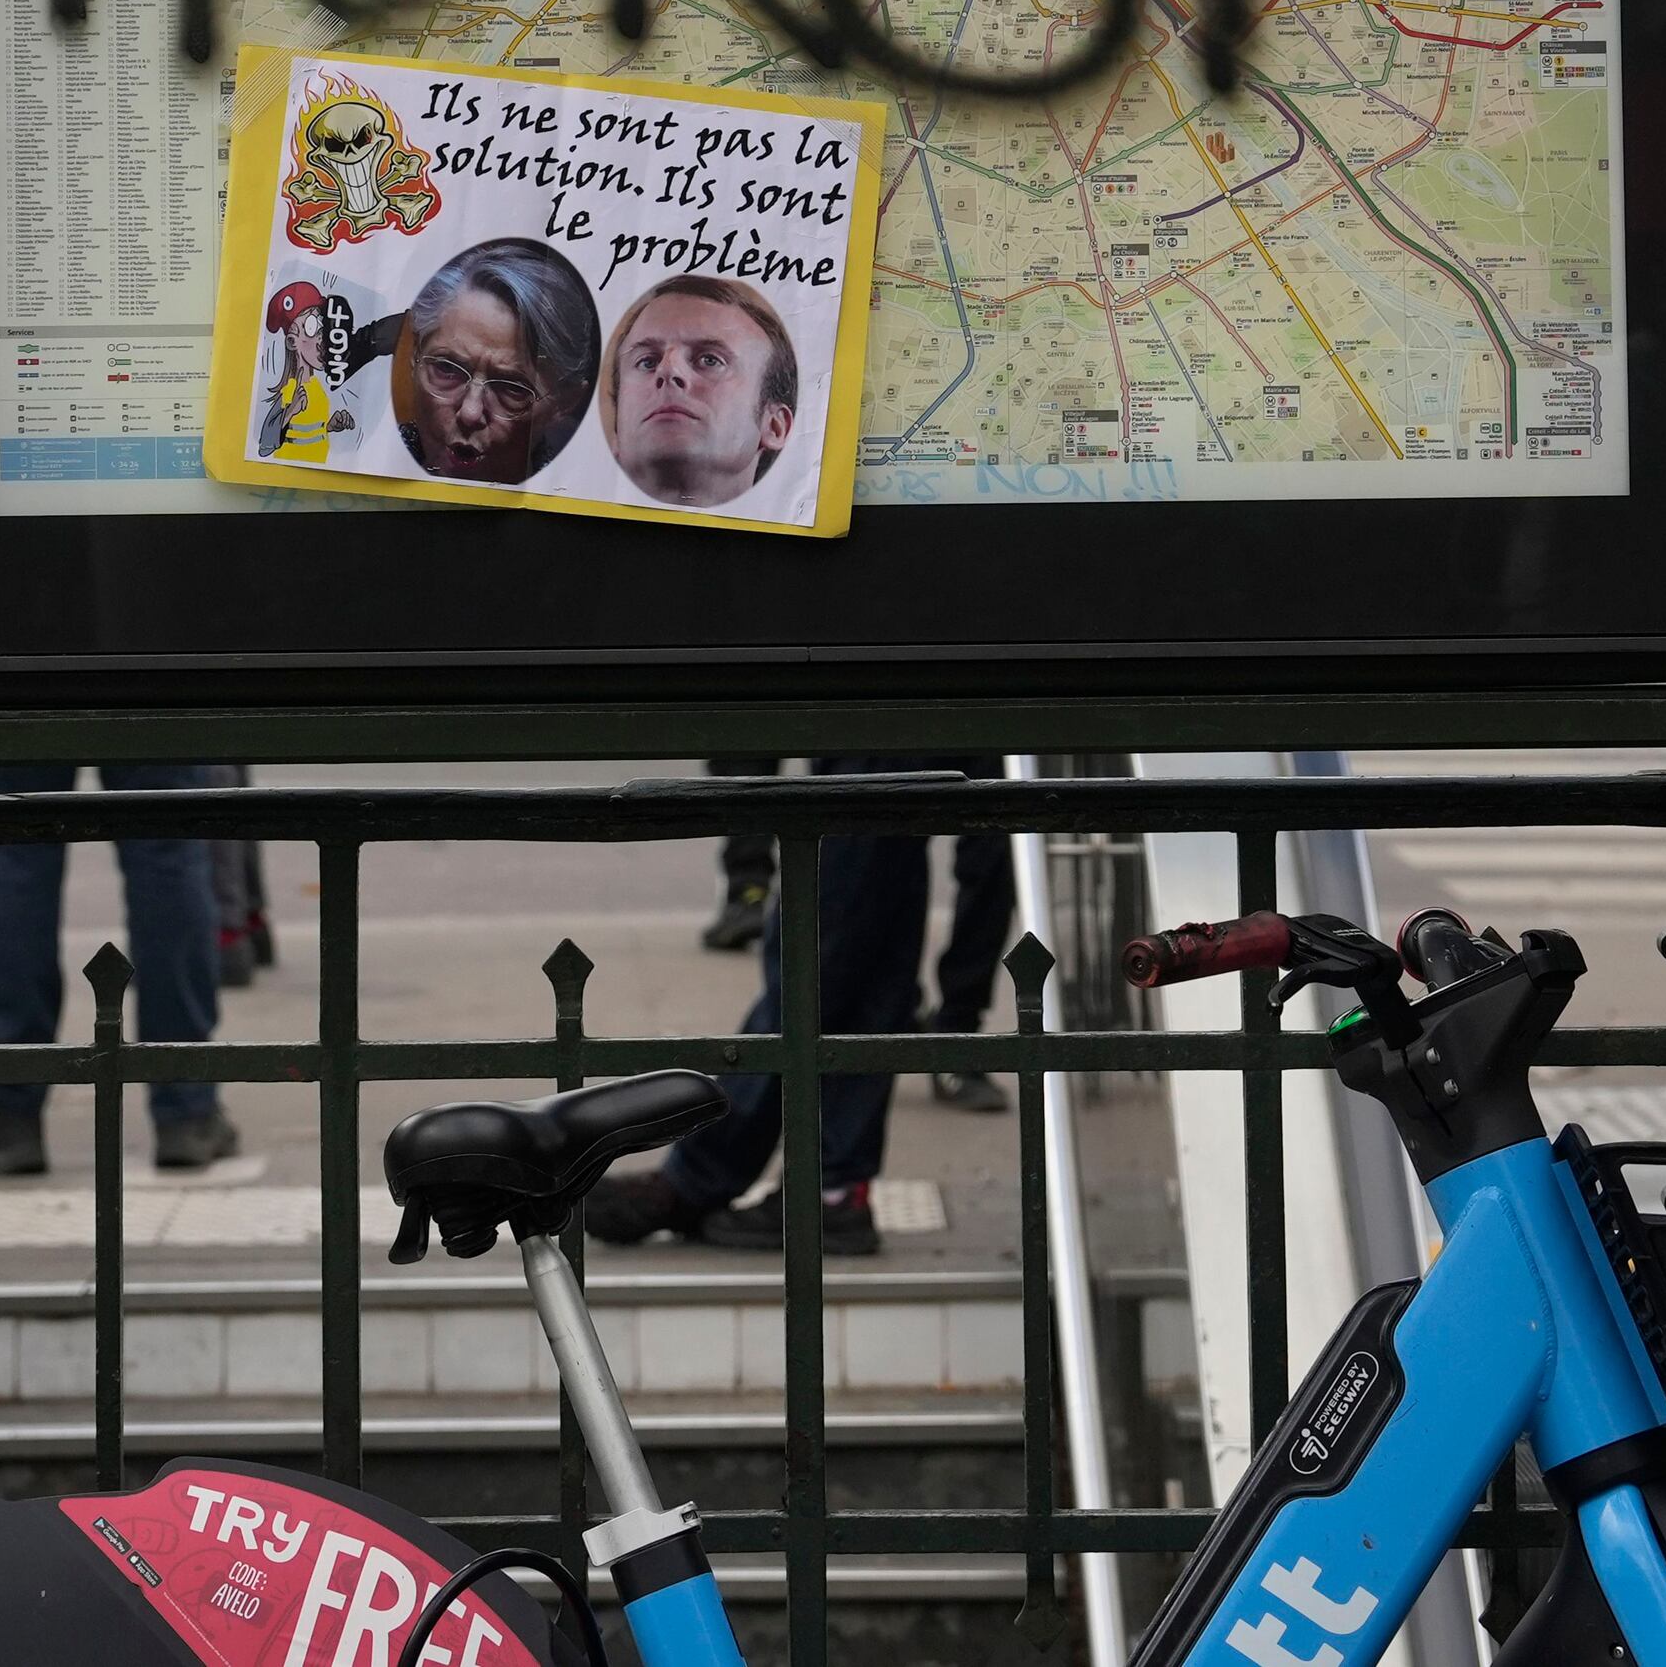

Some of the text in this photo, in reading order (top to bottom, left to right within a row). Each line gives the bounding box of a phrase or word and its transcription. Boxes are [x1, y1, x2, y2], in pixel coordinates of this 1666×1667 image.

[421, 82, 850, 169] Ils ne sont pas la
[432, 136, 848, 225] solution. Ils sont
[544, 191, 837, 291] le problème
[7, 328, 35, 337] Services
[975, 459, 1106, 500] NON
[1314, 1362, 1360, 1431] POWERED BY
[1323, 1367, 1369, 1437] SEGWAY
[185, 1484, 311, 1563] TRY
[211, 1583, 261, 1621] AVELO
[228, 1560, 268, 1592] CODE:
